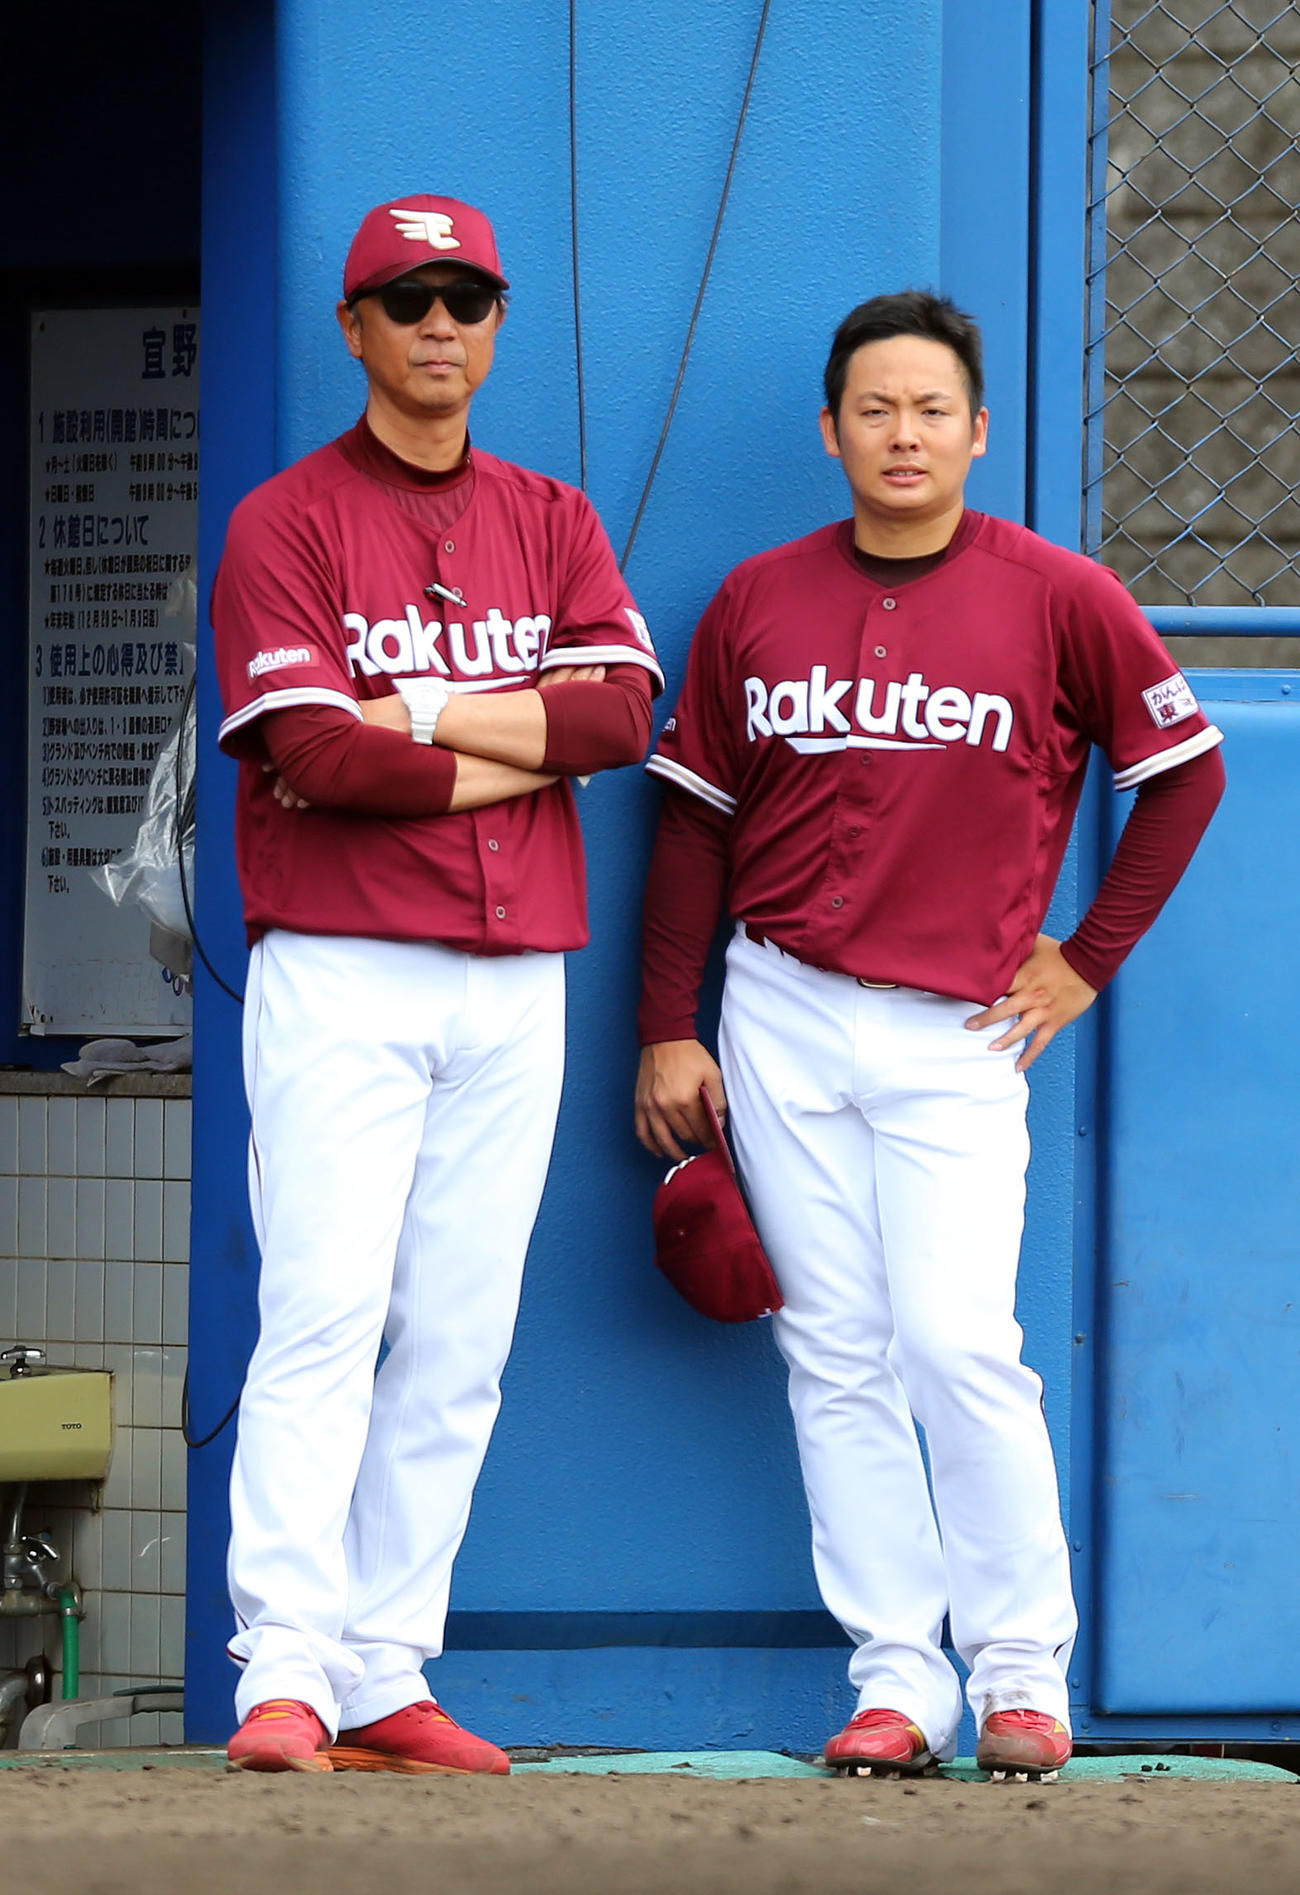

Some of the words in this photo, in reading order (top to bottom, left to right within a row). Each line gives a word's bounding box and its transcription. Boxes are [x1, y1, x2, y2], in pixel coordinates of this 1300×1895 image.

[142, 324, 198, 379] 宜野
[39, 411, 45, 443] 1
[39, 516, 47, 549] 2
[54, 514, 150, 548] 休館日について
[343, 604, 552, 678] Rakuten
[36, 644, 43, 677] 3
[248, 648, 312, 678] Rakuten
[744, 665, 1014, 752] Rakuten
